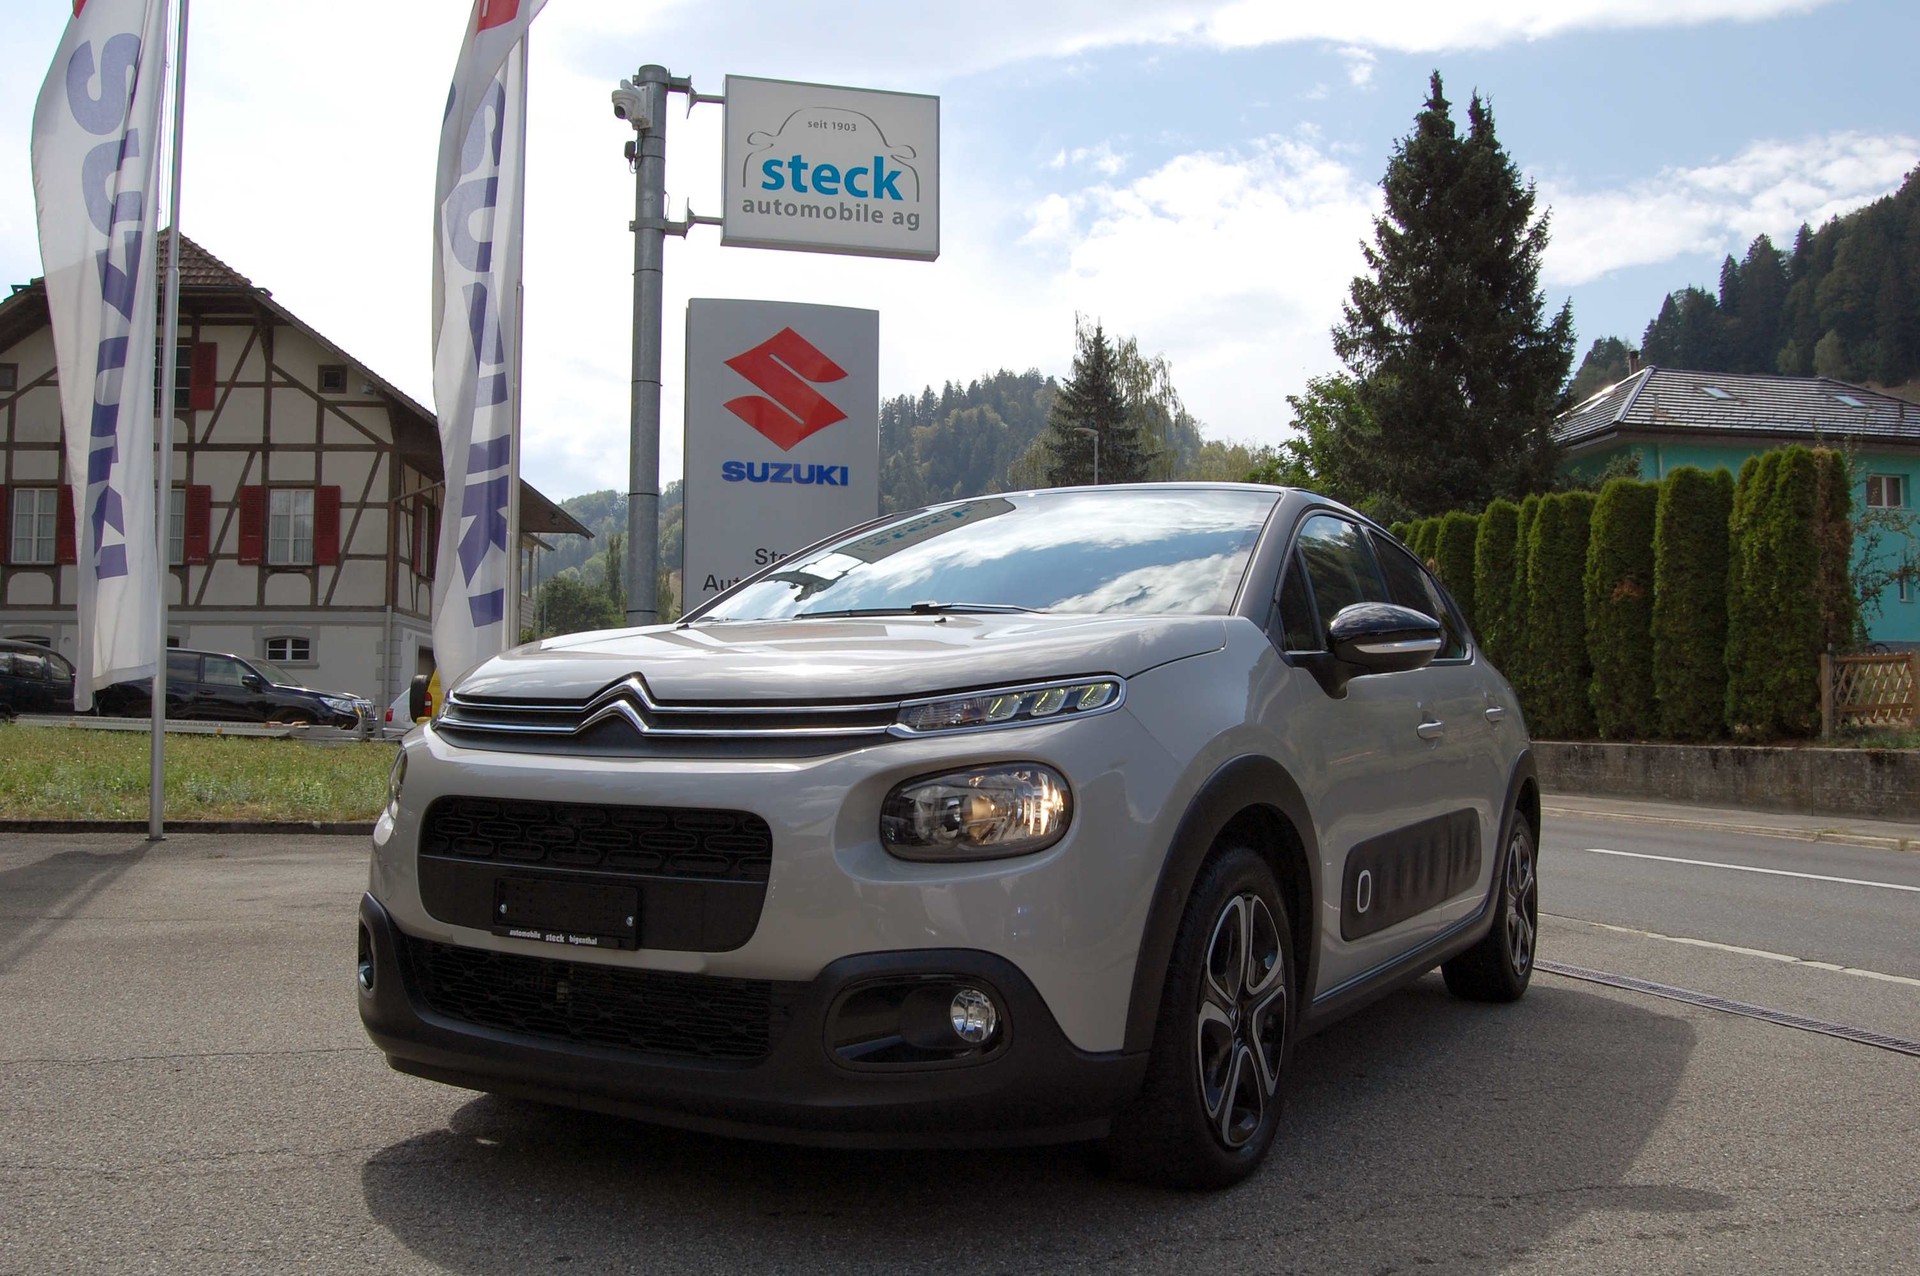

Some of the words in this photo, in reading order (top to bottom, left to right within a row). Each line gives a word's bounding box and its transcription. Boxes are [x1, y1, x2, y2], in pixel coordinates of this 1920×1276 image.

[807, 120, 828, 130] seit
[831, 121, 857, 132] 1903
[761, 154, 904, 201] steck
[742, 198, 884, 224] automobile
[892, 211, 920, 231] ag
[721, 460, 849, 487] SUZUKI
[509, 929, 541, 939] automobile
[545, 933, 565, 943] steck
